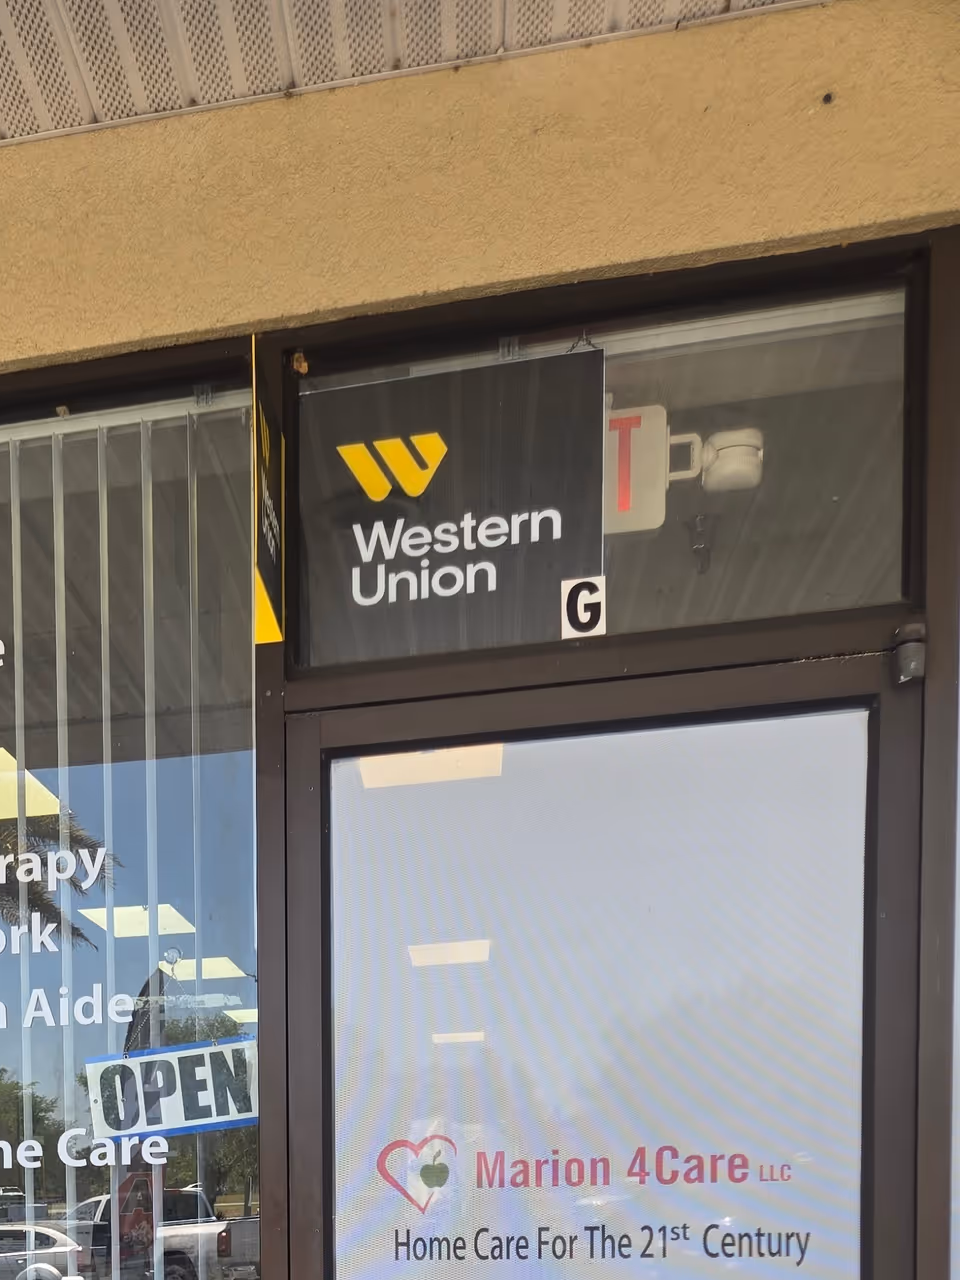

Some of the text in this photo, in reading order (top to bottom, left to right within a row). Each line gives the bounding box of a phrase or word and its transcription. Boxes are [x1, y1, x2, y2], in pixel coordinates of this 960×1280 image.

[352, 507, 562, 564] Western
[351, 558, 497, 607] Union
[566, 580, 601, 633] G
[22, 983, 134, 1028] Aide
[99, 1047, 253, 1131] OPEN
[57, 1128, 169, 1169] Care
[476, 1145, 792, 1189] Marion 4Care LLC
[394, 1222, 811, 1265] Home Care For The 21st Century
